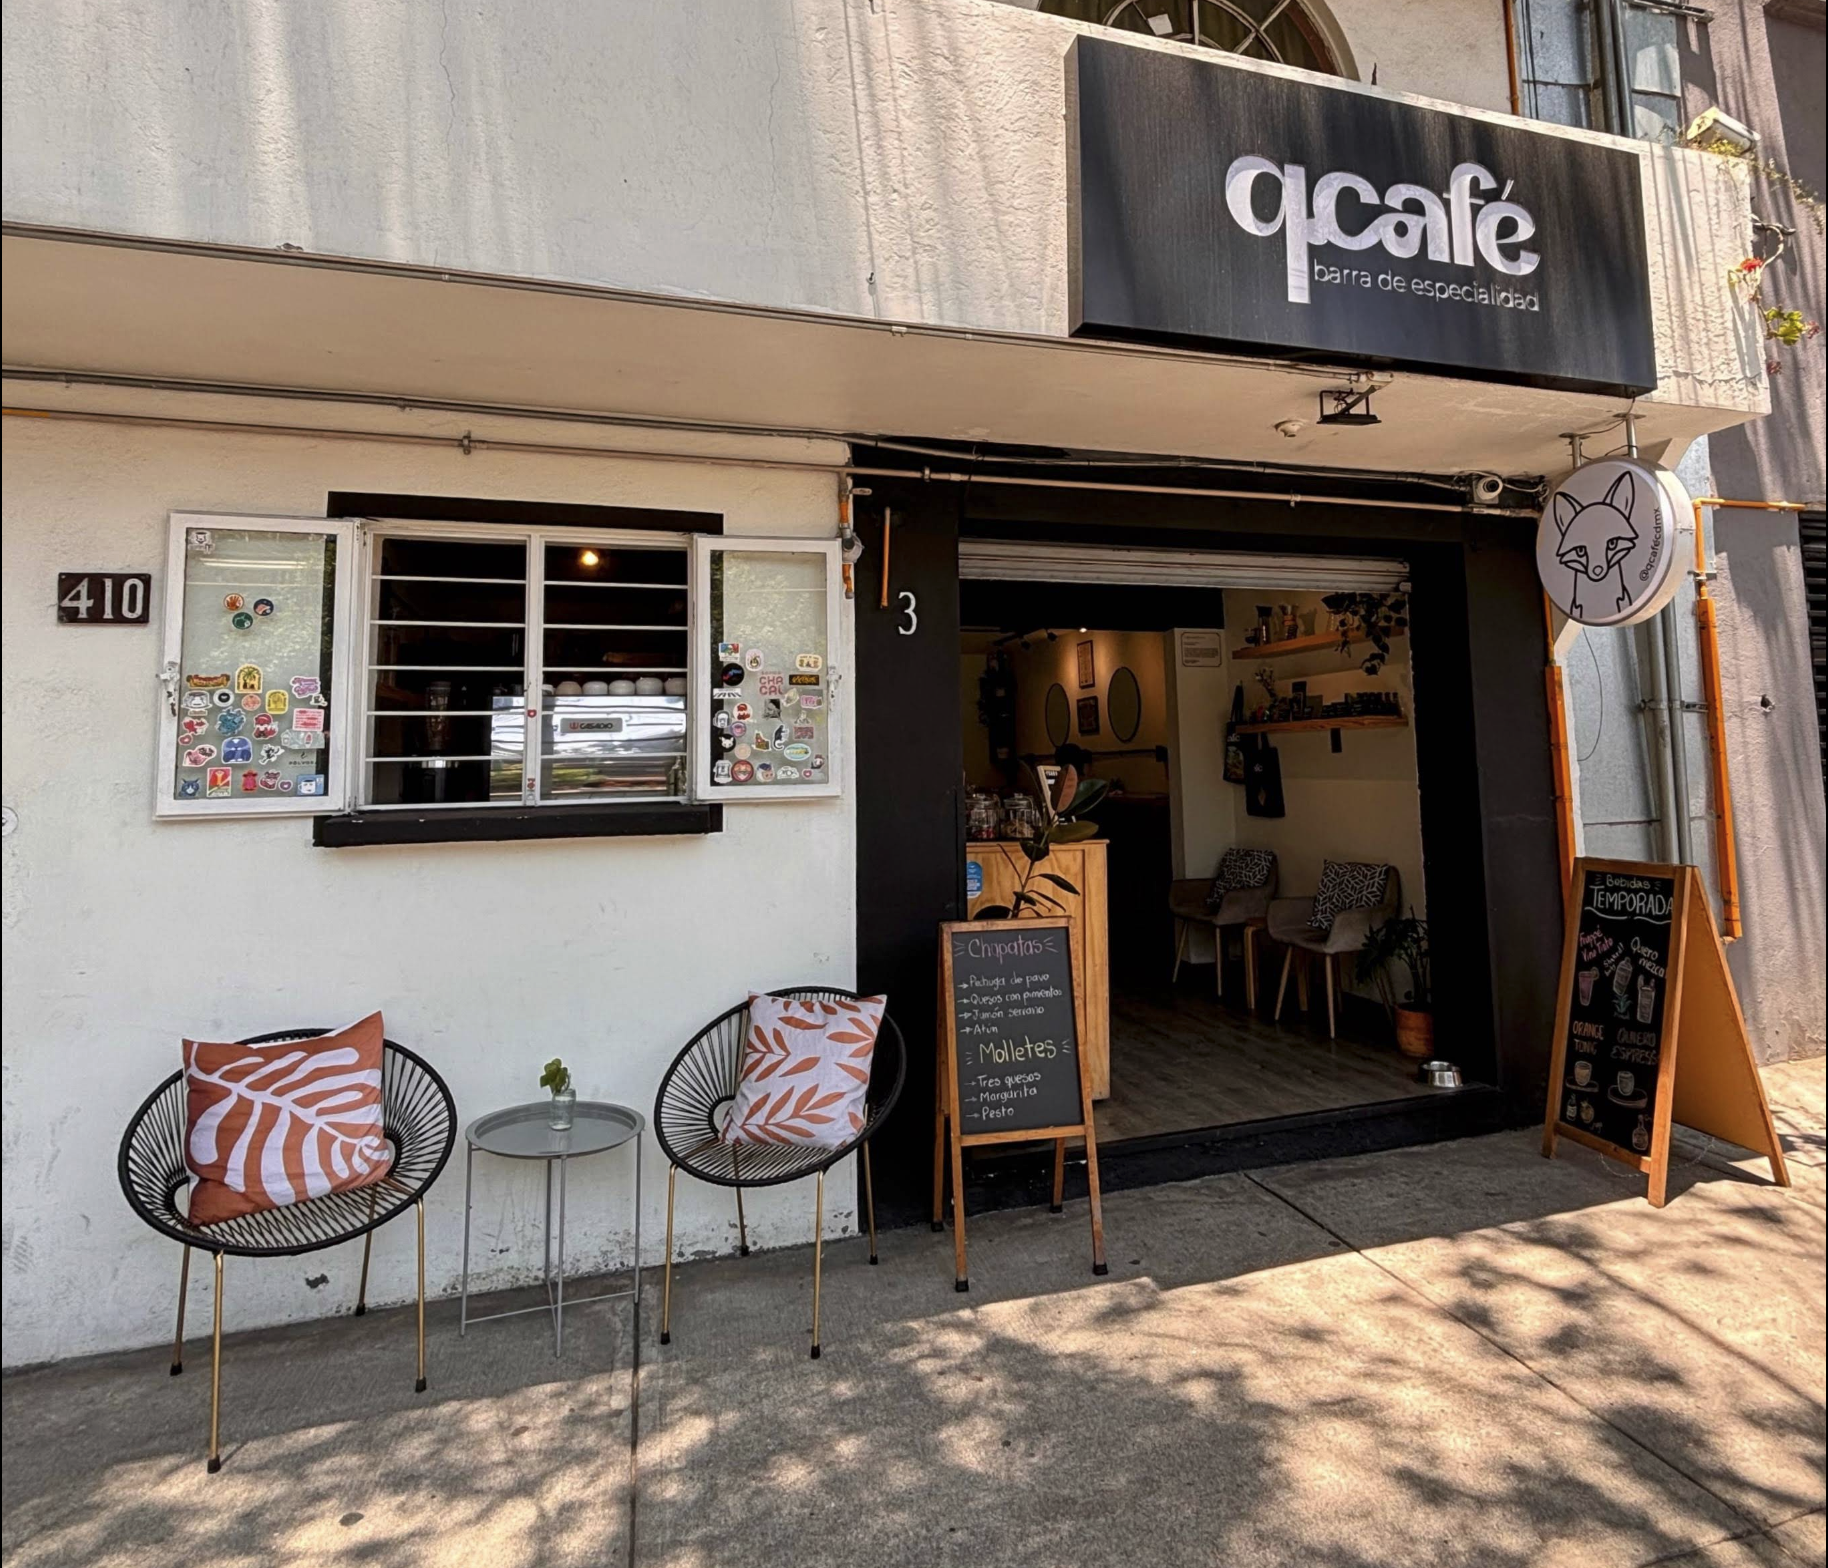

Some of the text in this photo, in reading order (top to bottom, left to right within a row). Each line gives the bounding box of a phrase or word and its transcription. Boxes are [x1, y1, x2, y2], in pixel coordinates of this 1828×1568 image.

[1225, 154, 1541, 304] qcafé
[1313, 258, 1540, 312] barra de especialidad
[60, 577, 145, 619] 410
[898, 591, 918, 635] 3
[1606, 874, 1651, 889] Bebidas
[1589, 885, 1673, 915] TEMPORADA
[968, 934, 1043, 964] Chapatas
[1638, 957, 1666, 978] mezca
[969, 970, 1050, 991] Pechuga de pavo
[970, 993, 1003, 1006] Quesos
[1005, 993, 1021, 1003] con
[973, 1023, 999, 1035] Atún
[979, 1035, 1057, 1064] Molletes
[977, 1072, 1042, 1089] Tres quesos
[980, 1084, 1038, 1104] Margarita
[981, 1105, 1015, 1121] Pesto
